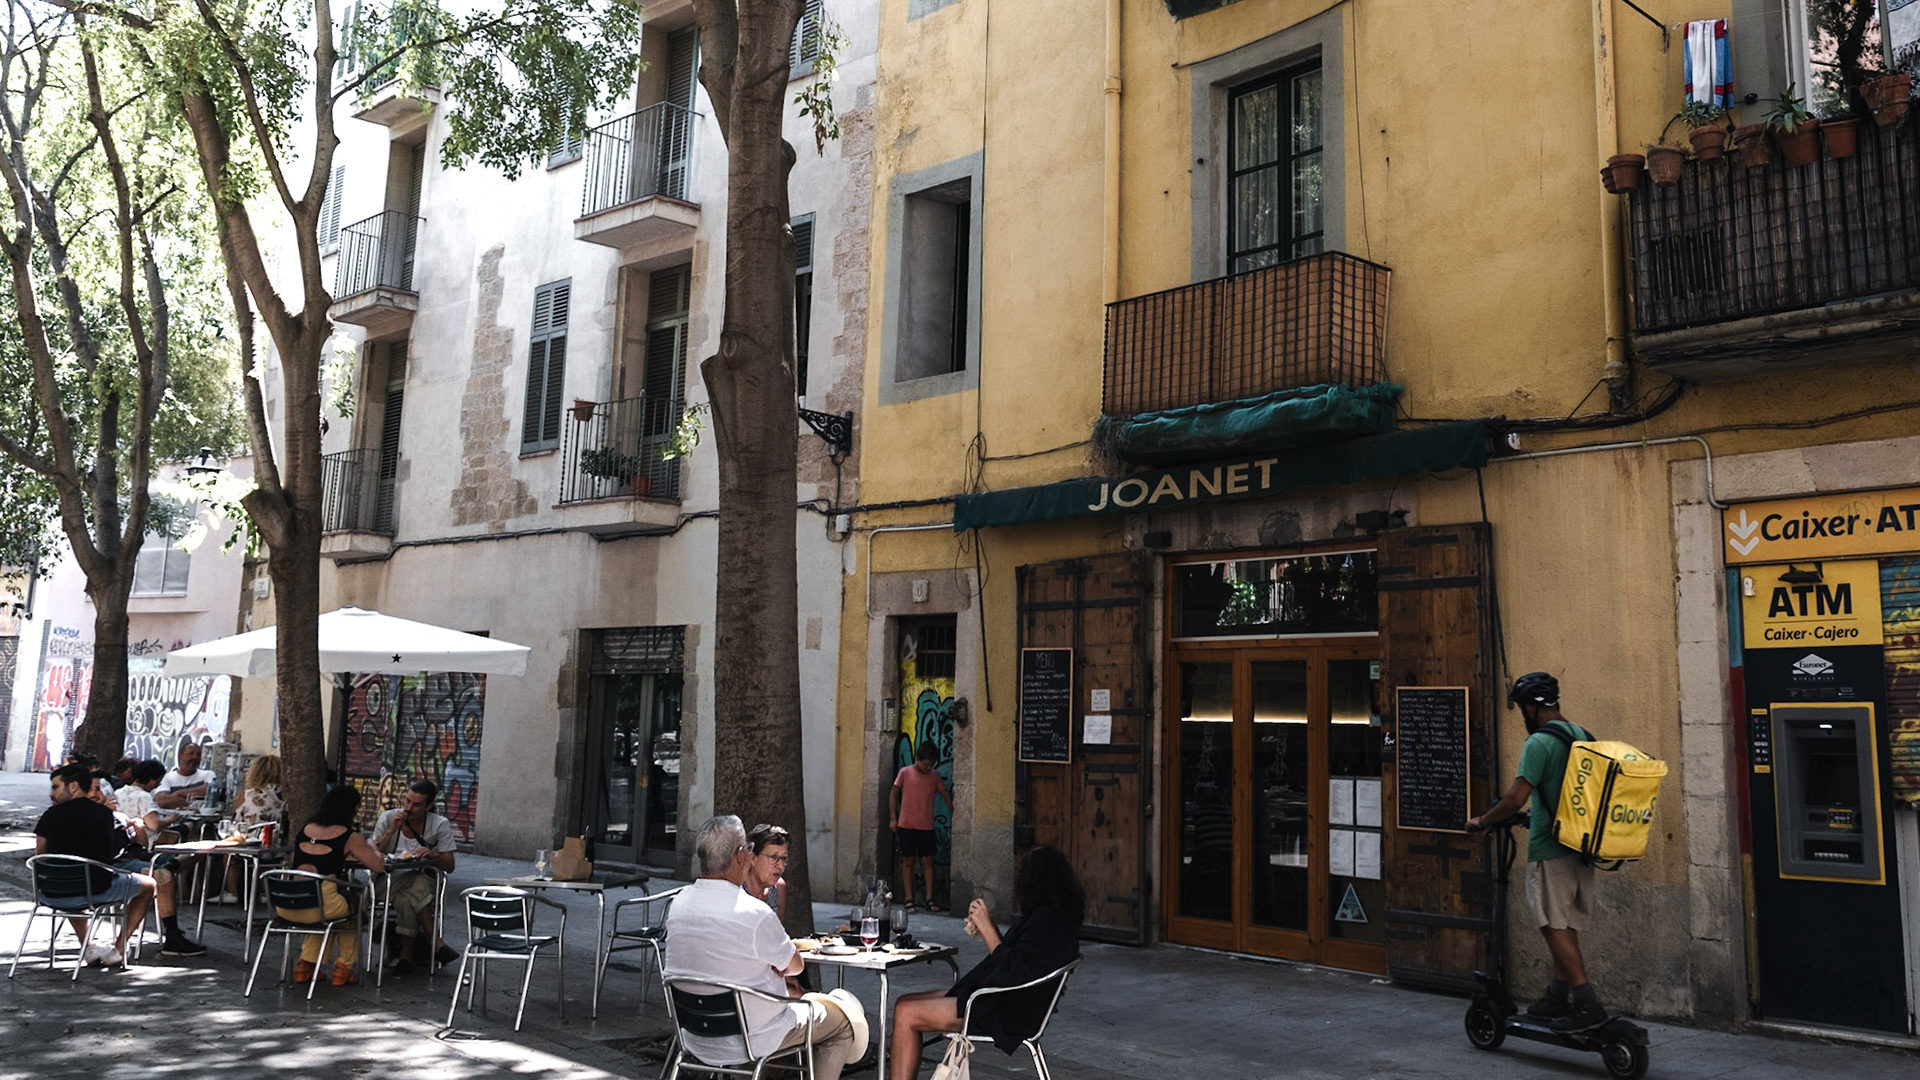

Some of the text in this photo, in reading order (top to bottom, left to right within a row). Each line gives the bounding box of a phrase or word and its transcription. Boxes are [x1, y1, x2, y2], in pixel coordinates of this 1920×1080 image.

[1088, 458, 1279, 512] JOANET
[1768, 583, 1853, 618] ATM
[1799, 661, 1828, 669] Euronet
[1570, 757, 1594, 806] Glovo
